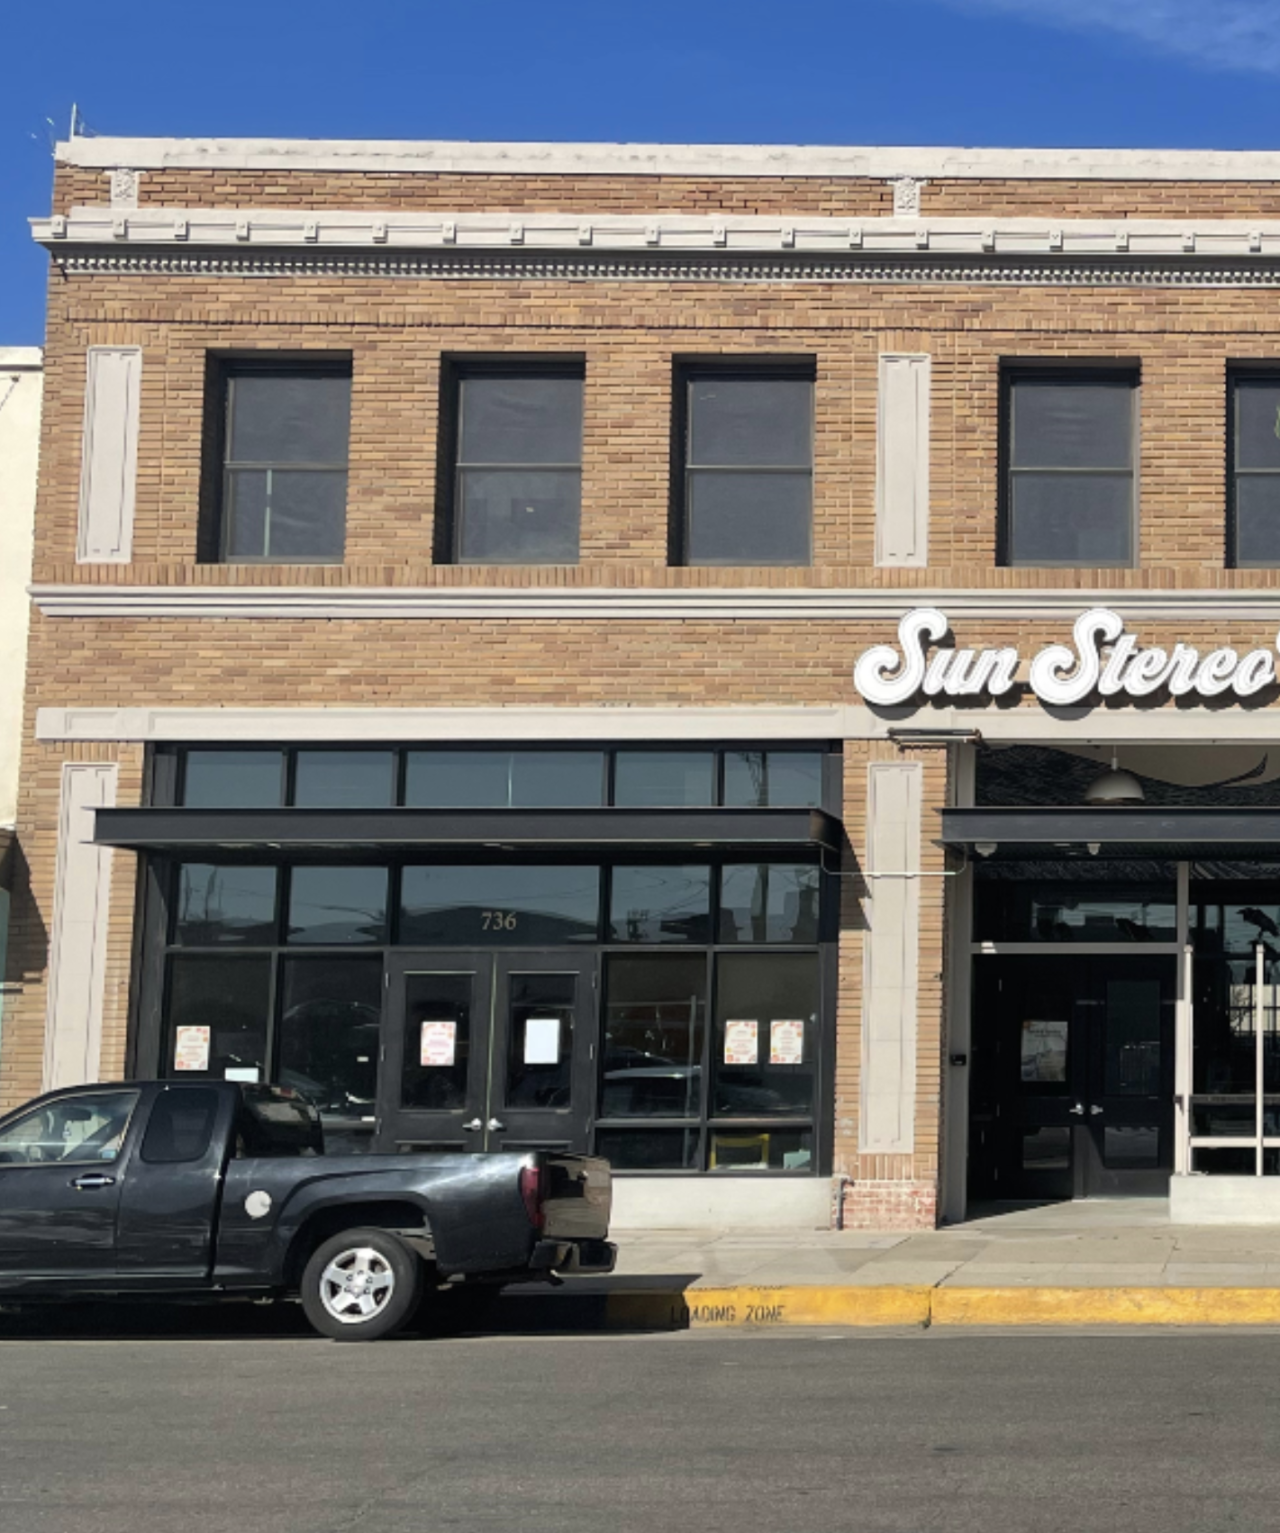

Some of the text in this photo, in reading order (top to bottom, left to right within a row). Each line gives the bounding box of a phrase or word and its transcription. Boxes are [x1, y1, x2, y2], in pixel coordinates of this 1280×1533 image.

[854, 608, 1019, 705] Sun
[1029, 608, 1275, 705] Stereo
[481, 911, 517, 930] 736
[745, 1304, 785, 1322] ZONE
